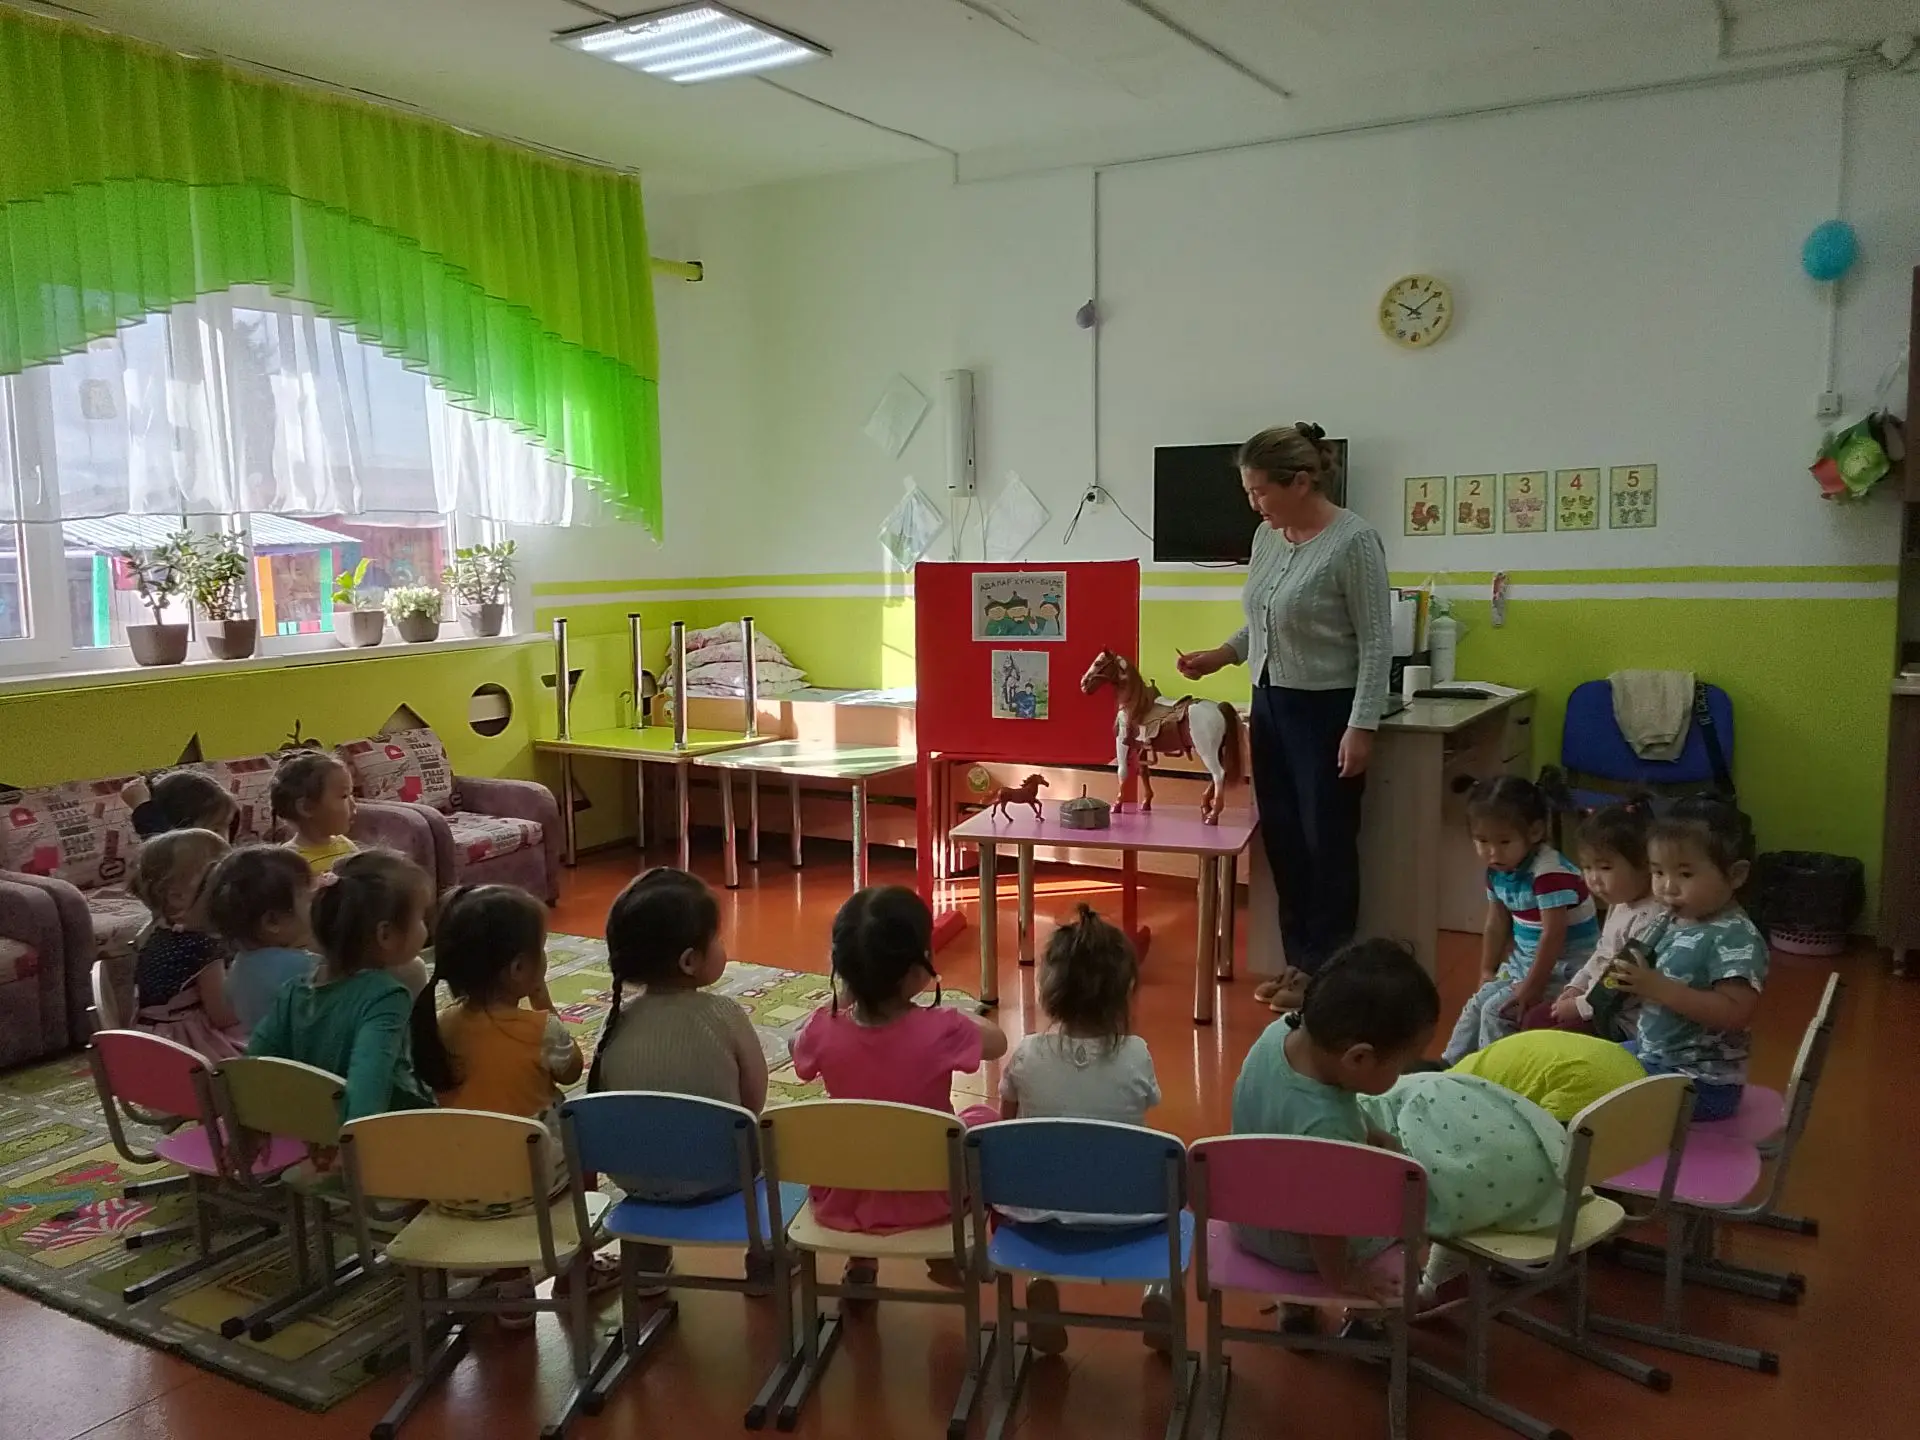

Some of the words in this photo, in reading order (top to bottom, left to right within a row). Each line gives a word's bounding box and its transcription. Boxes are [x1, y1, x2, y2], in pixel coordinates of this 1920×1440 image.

[1520, 477, 1531, 493] 3
[1570, 474, 1582, 490] 4
[1628, 471, 1639, 488] 5
[1420, 482, 1428, 498] 1
[1470, 480, 1481, 496] 2
